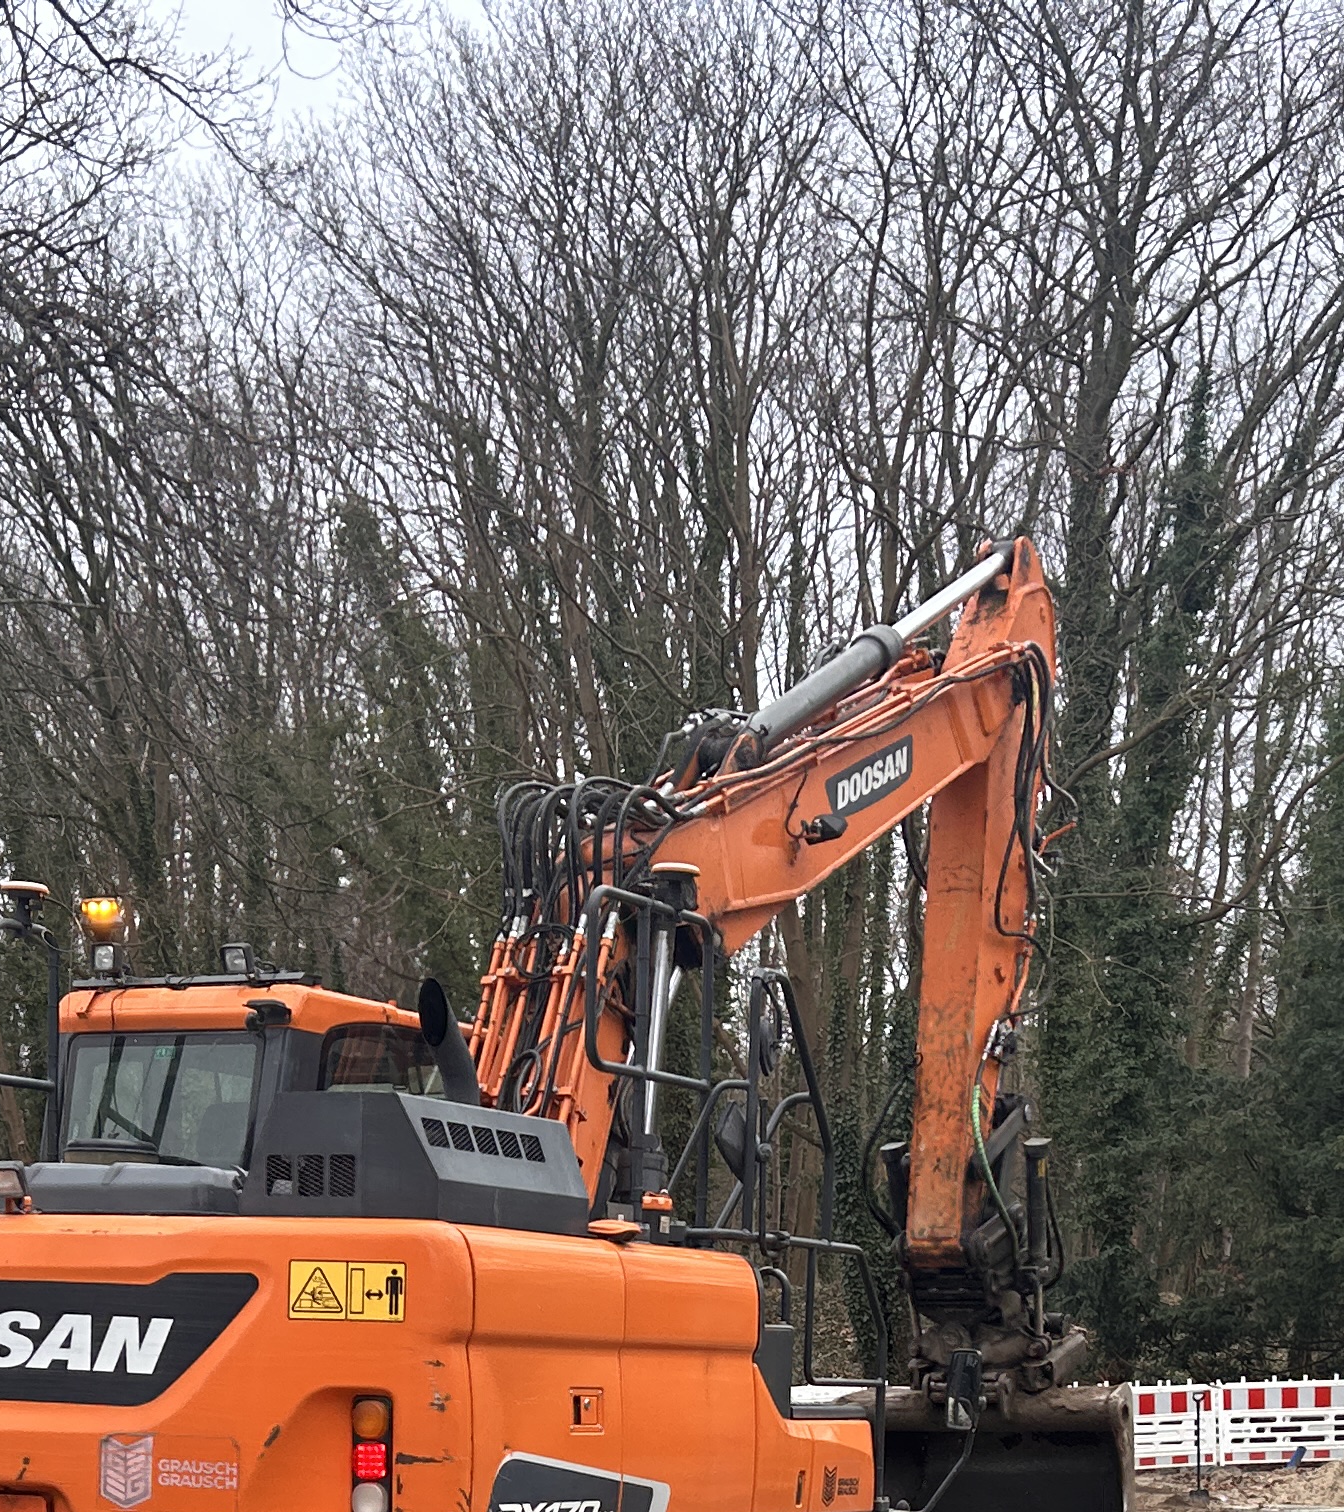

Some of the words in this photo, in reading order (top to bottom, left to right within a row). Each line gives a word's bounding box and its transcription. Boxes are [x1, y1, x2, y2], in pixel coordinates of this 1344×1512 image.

[837, 746, 908, 811] DOOSAN
[158, 1458, 238, 1476] GRAUSCH
[158, 1473, 238, 1490] GRAUSCH
